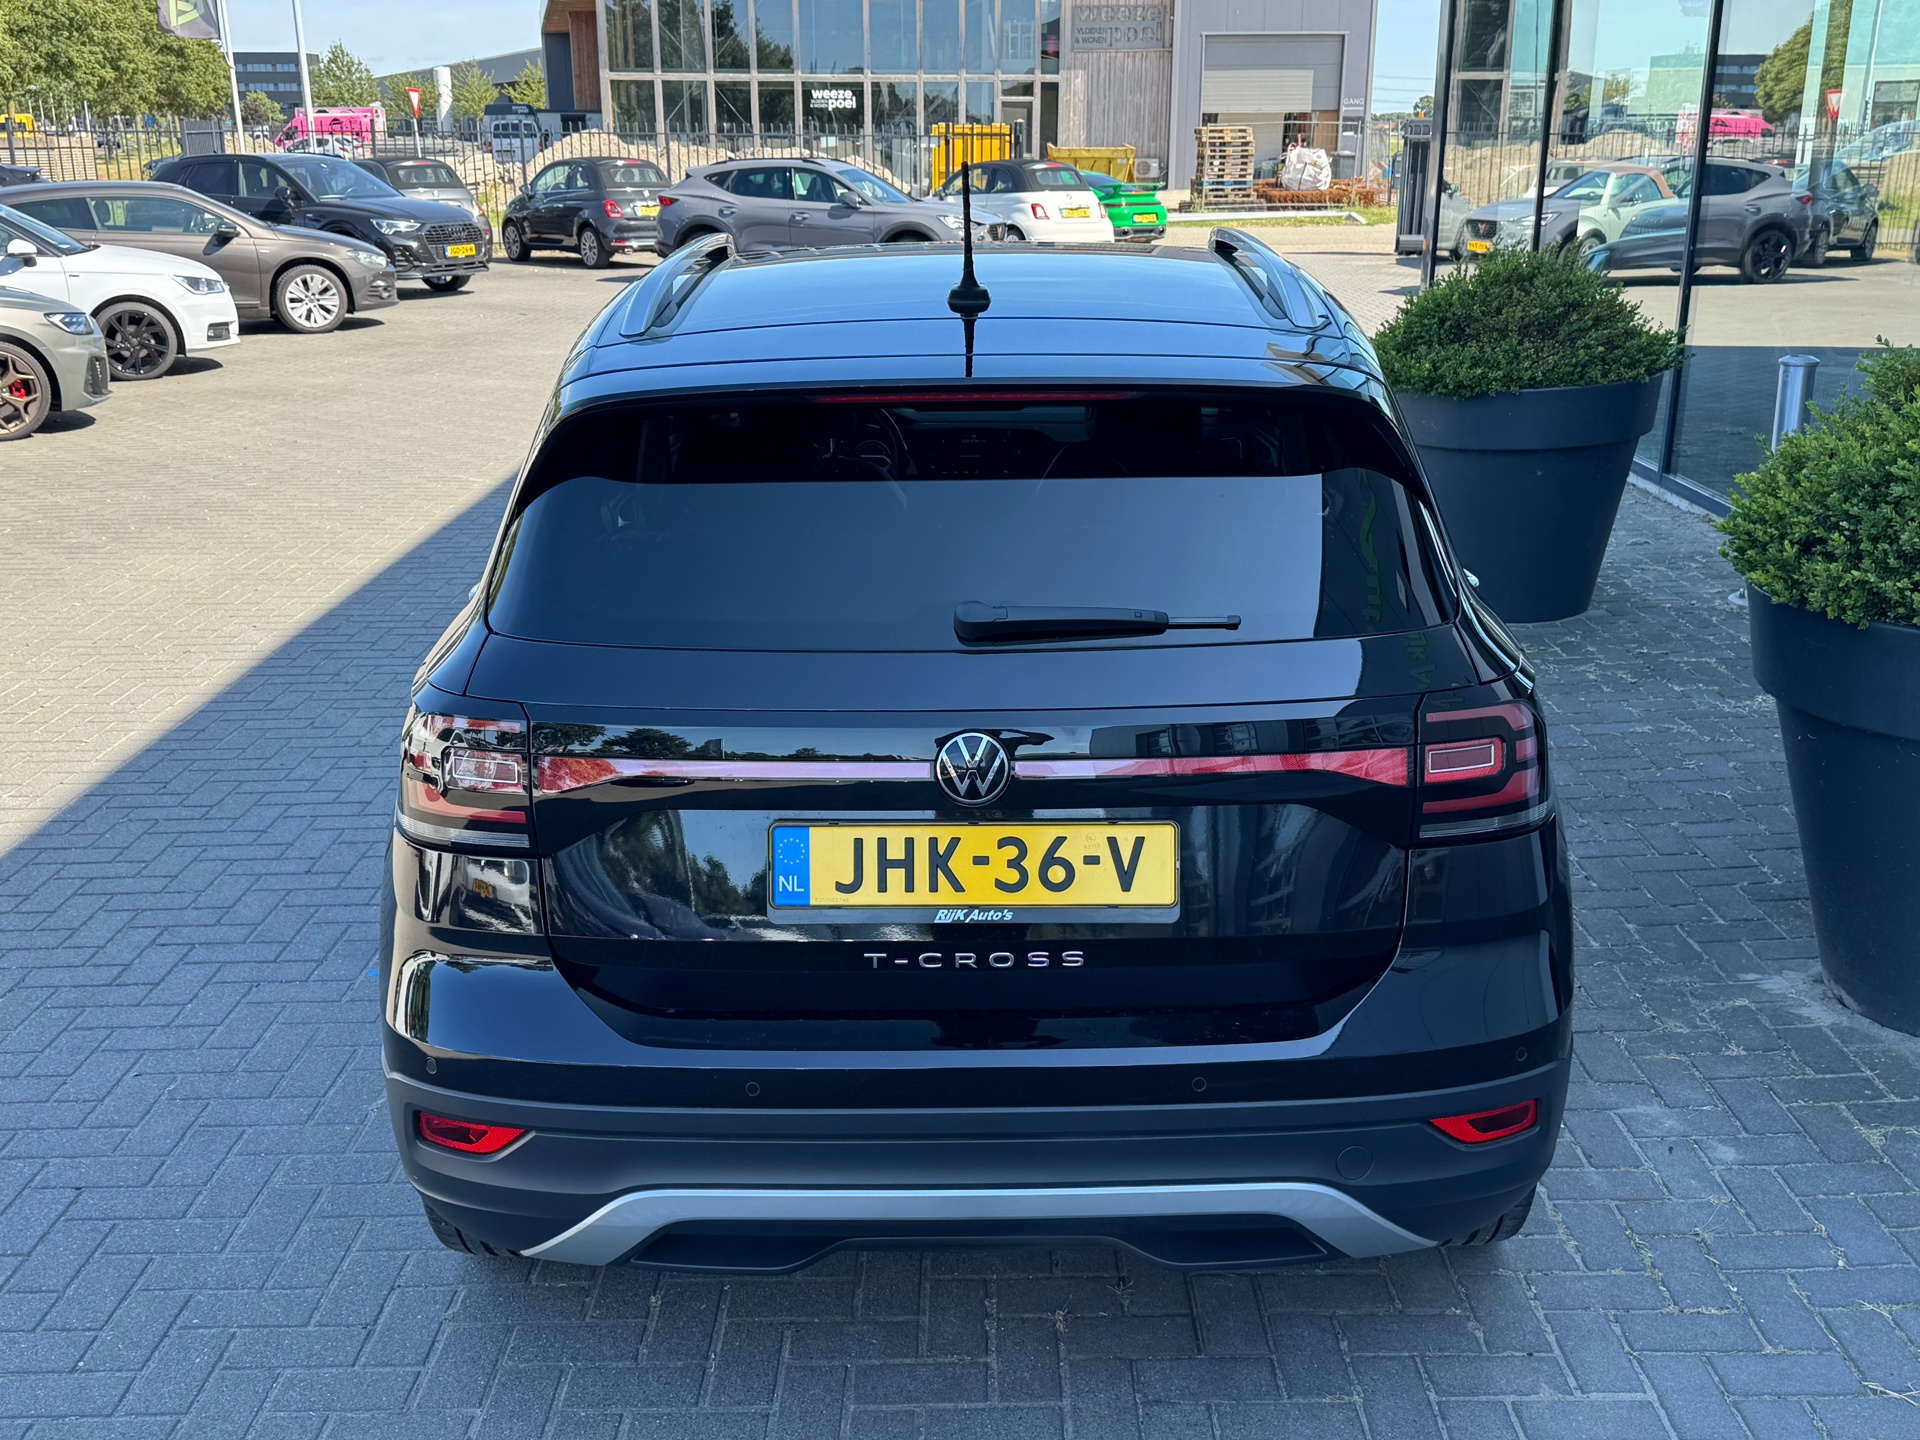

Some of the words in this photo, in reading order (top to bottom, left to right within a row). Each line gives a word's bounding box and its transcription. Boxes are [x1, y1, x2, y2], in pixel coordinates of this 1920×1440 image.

[1077, 6, 1162, 21] weeze
[1076, 27, 1107, 35] VLOEREN
[1107, 21, 1162, 47] poel
[1081, 36, 1107, 44] WONEN
[811, 89, 853, 99] weeze
[1343, 97, 1365, 105] GANG
[828, 96, 856, 111] poel
[778, 875, 805, 892] NL
[835, 836, 1146, 893] JHK-36-V
[965, 909, 1014, 923] Auto's
[864, 951, 1084, 969] T-CROSS
